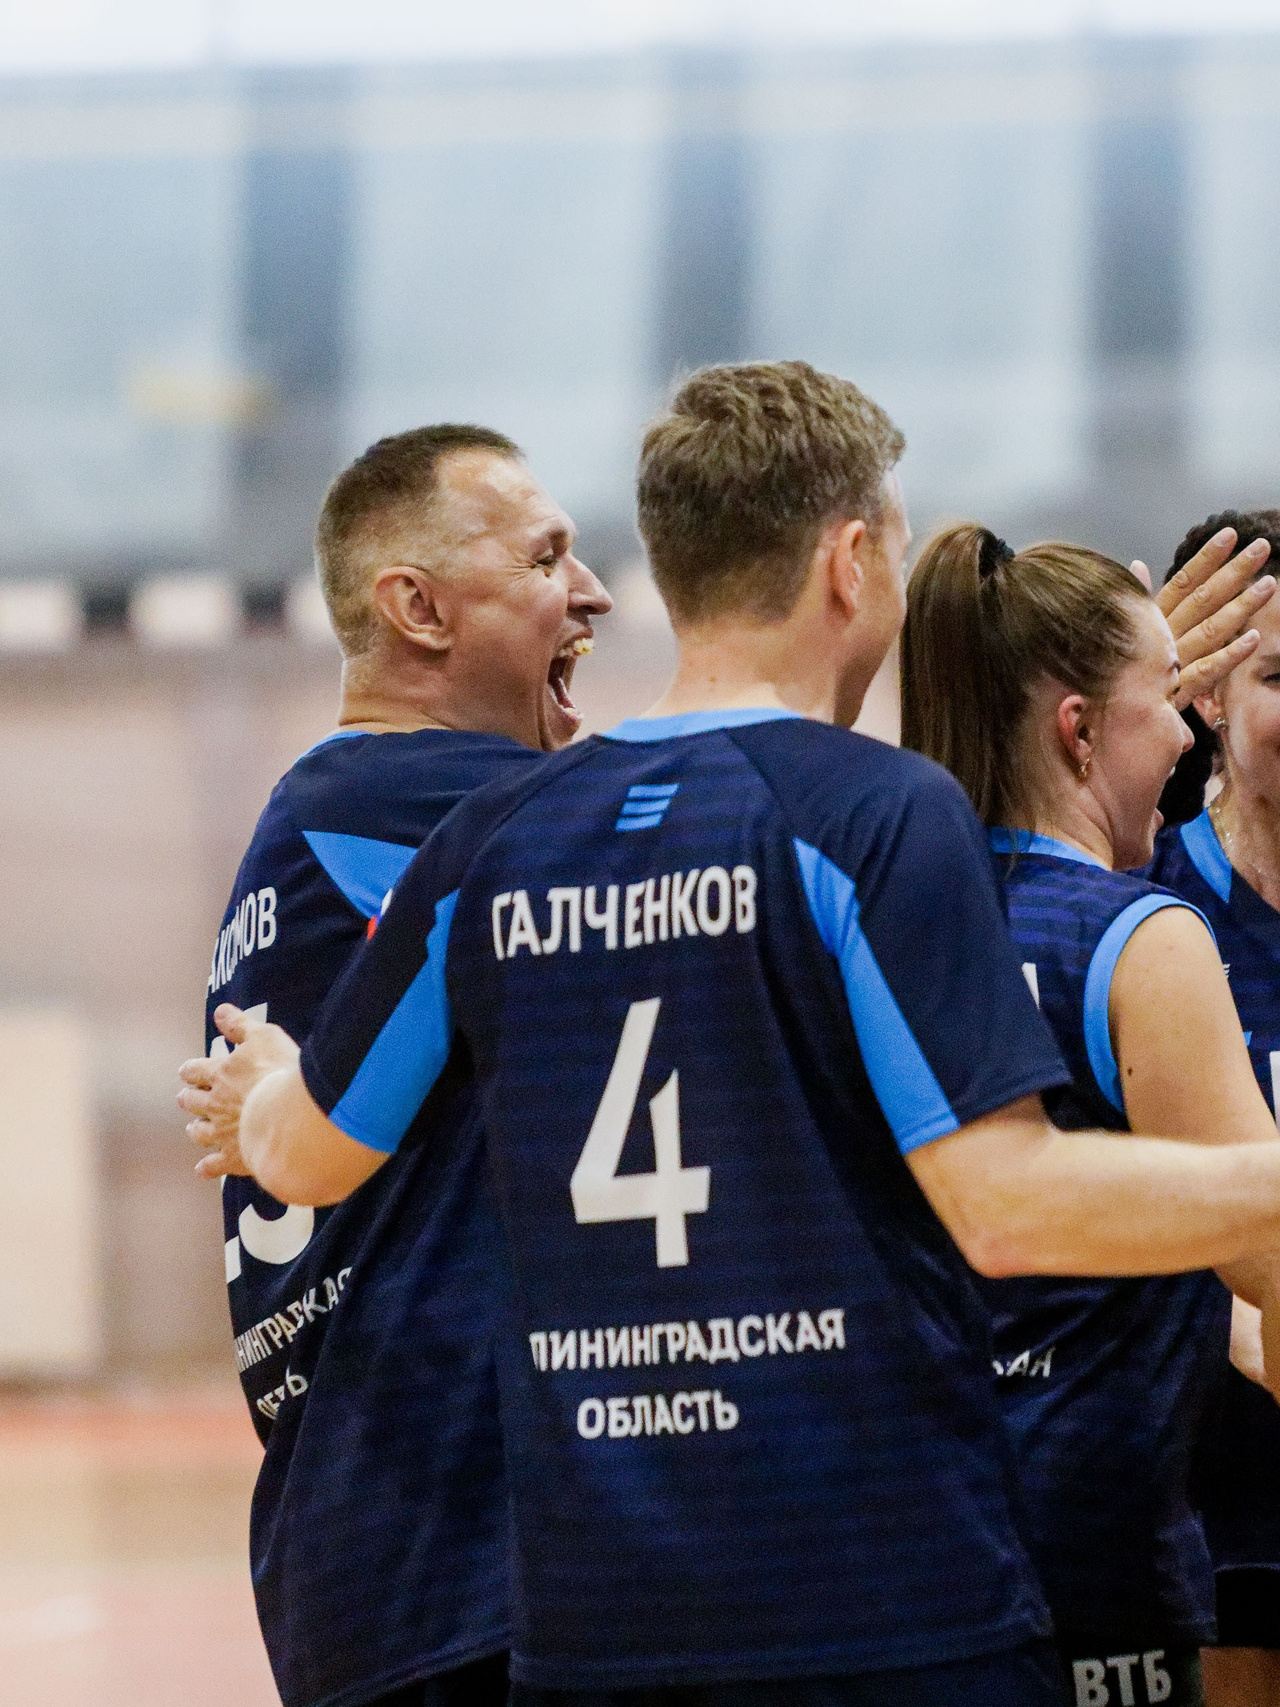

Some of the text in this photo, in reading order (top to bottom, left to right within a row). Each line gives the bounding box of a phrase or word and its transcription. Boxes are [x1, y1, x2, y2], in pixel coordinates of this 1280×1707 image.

[492, 865, 758, 961] ГАЛЧЕНКОВ
[570, 998, 711, 1268] 4
[576, 1389, 740, 1440] ОБЛАСТЬ
[1072, 1649, 1172, 1707] ВТБ
